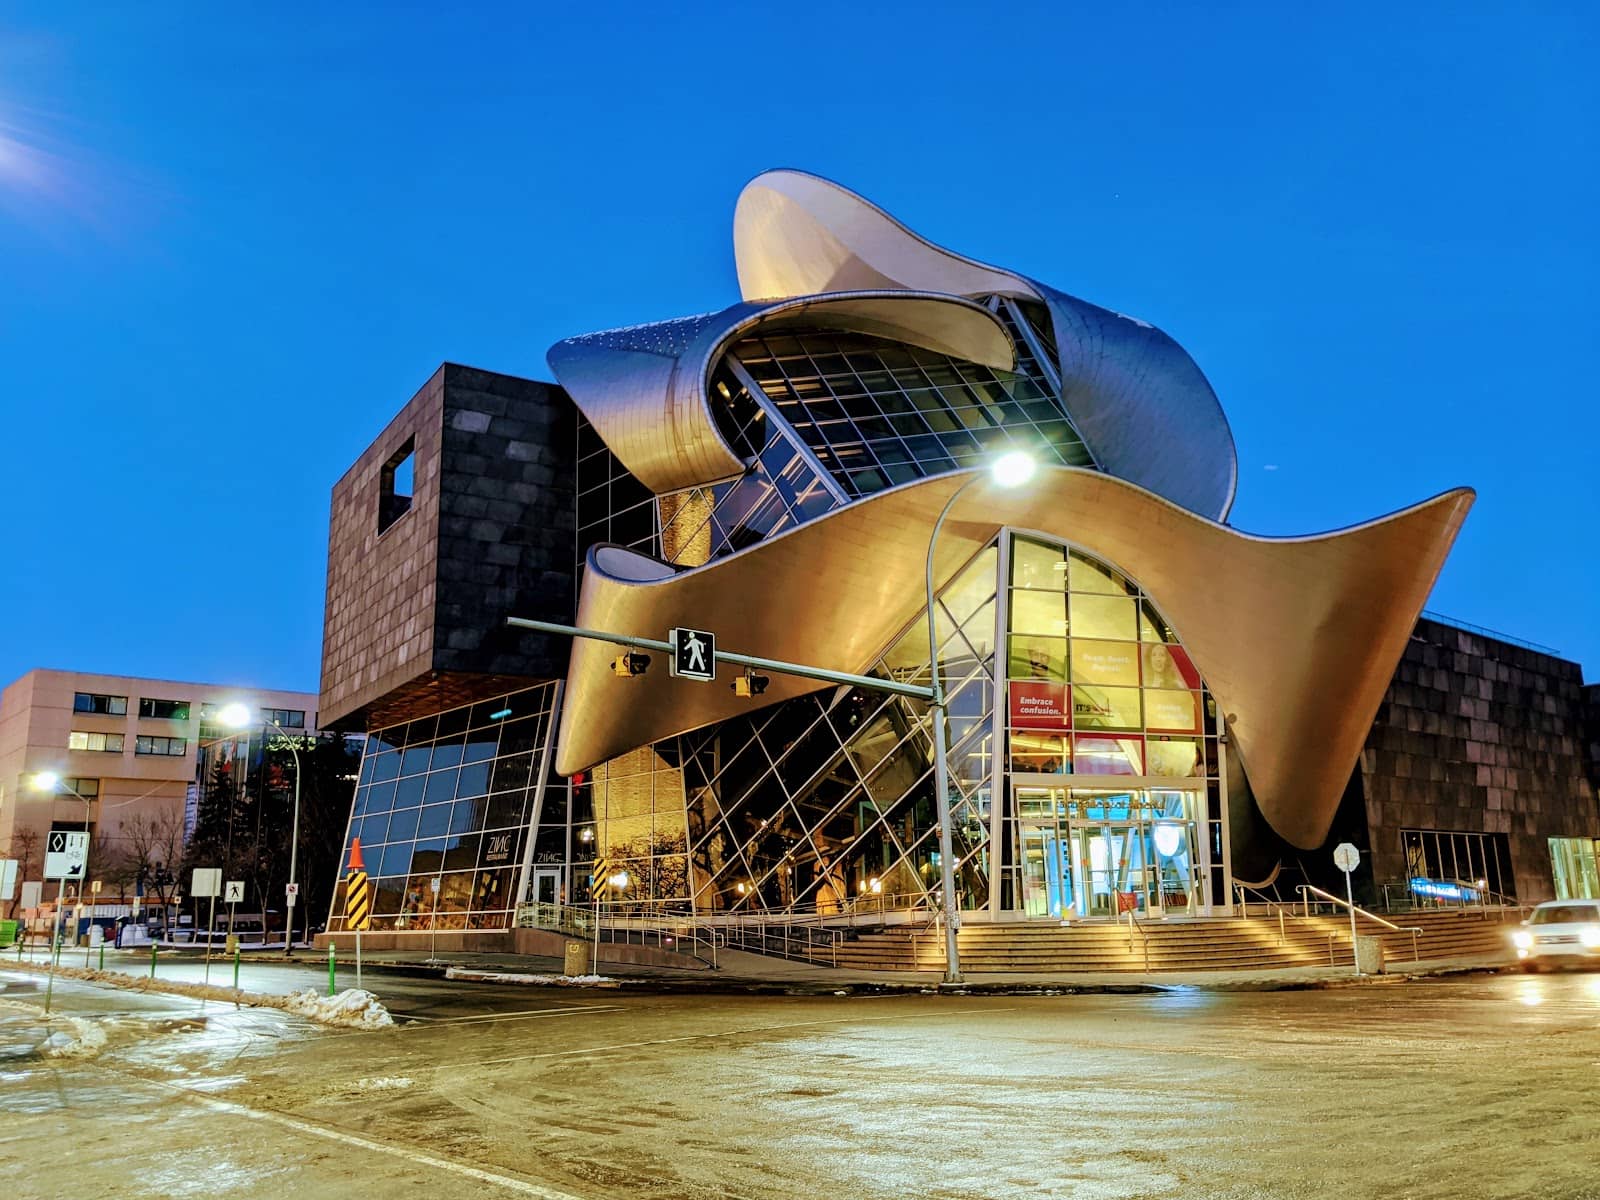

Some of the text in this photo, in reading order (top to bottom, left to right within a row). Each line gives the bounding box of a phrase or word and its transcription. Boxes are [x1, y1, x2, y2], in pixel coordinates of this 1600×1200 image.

[1020, 696, 1054, 706] Embrace
[1020, 706, 1062, 715] confusion.
[488, 835, 511, 853] ZINC
[537, 852, 564, 863] ZINC
